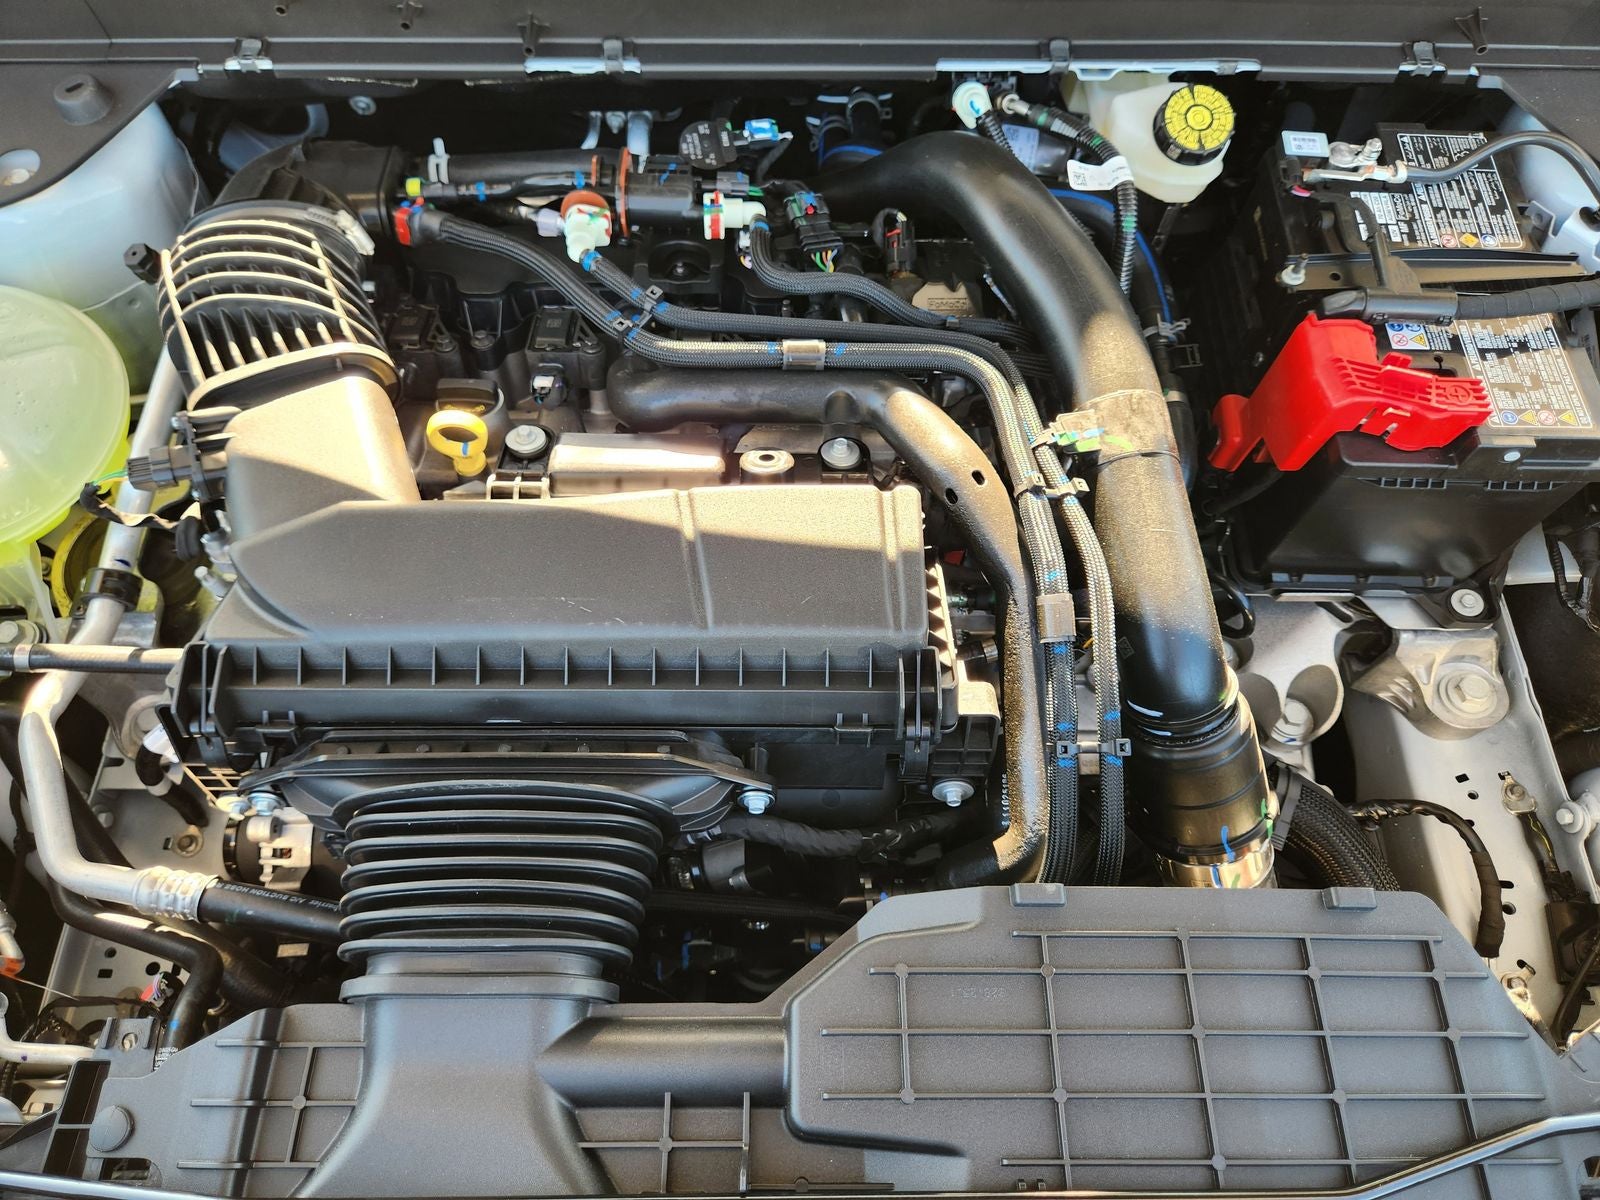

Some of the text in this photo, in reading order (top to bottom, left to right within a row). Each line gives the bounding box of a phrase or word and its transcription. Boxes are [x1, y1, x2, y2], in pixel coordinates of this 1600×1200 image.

[1391, 194, 1407, 218] FoMoCo
[224, 883, 249, 893] HOSE
[250, 889, 288, 901] SUCTION
